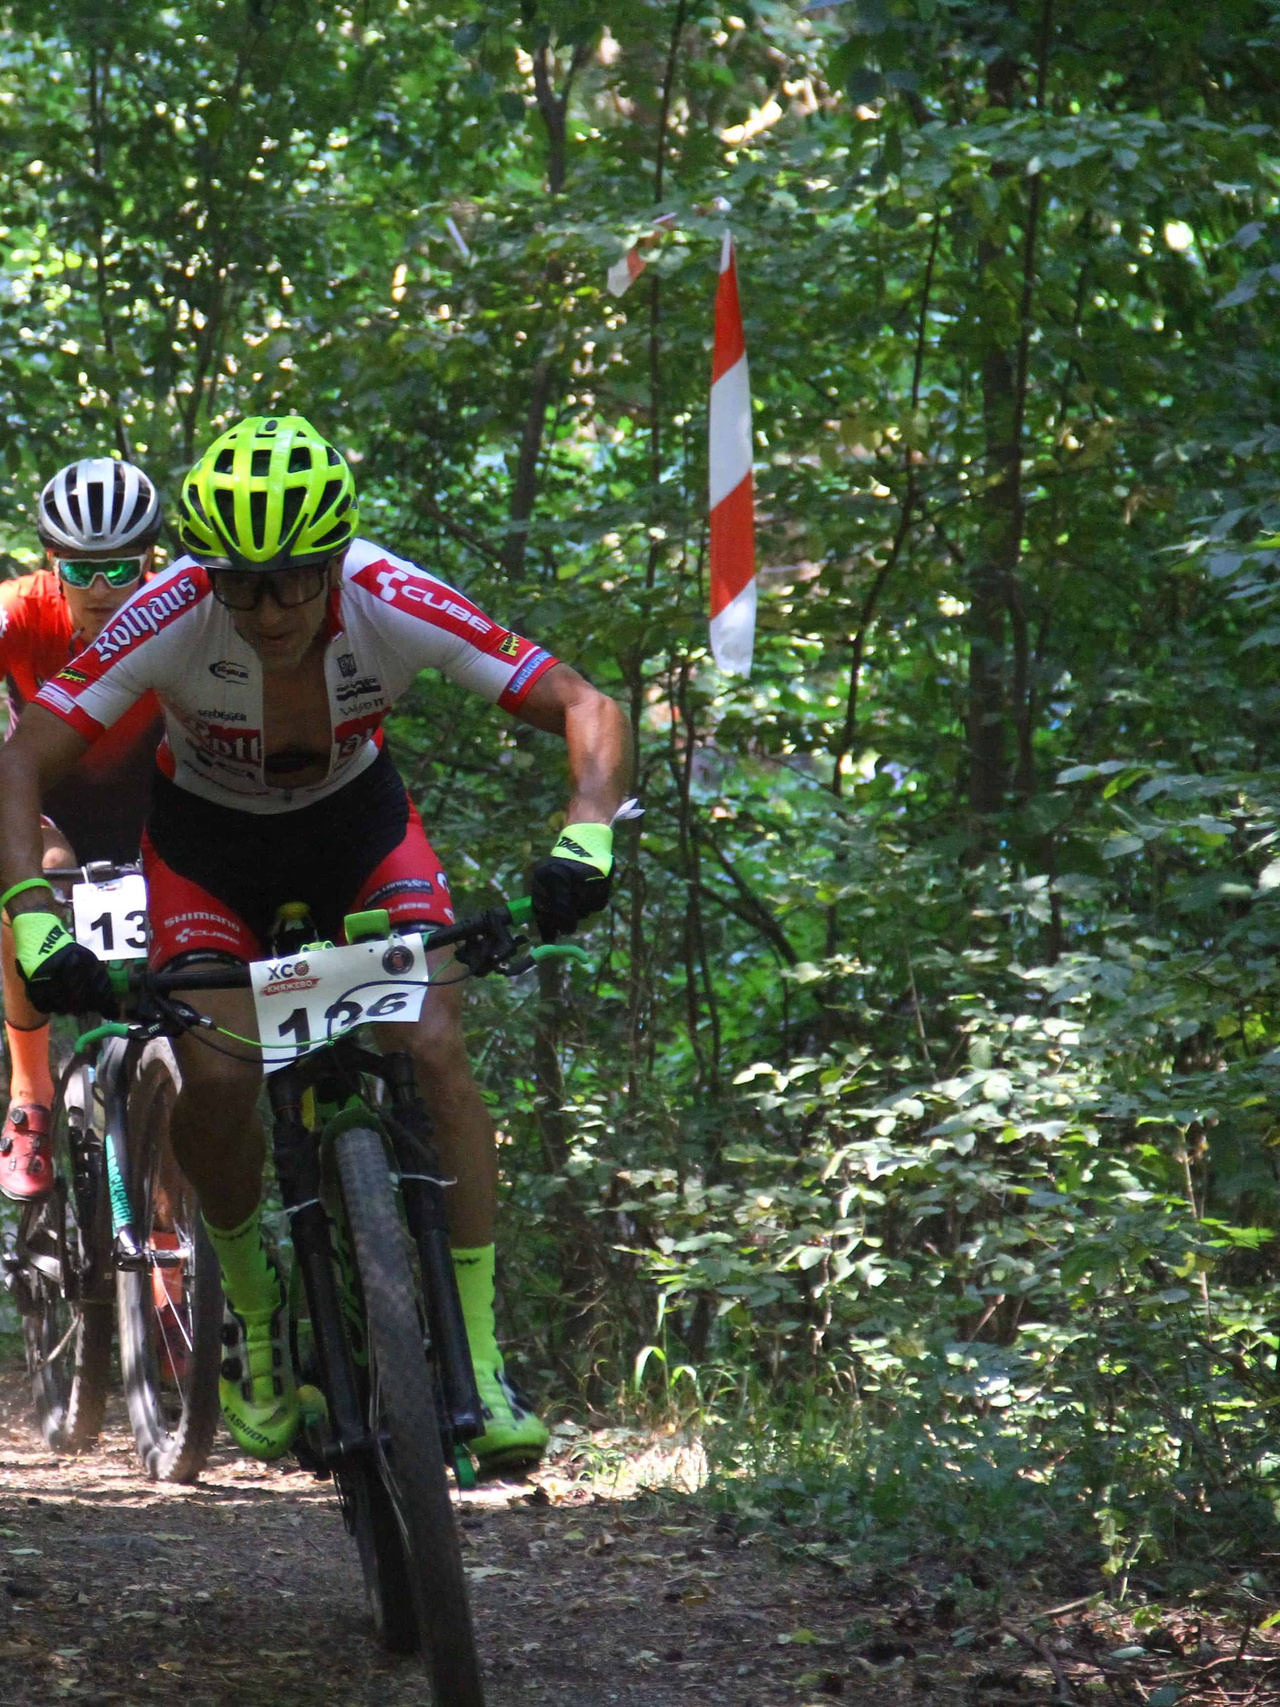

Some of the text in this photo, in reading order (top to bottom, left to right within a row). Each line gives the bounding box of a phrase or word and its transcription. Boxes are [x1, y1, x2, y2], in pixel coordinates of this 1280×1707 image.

[92, 576, 198, 663] Rothaus
[401, 584, 493, 635] CUBE
[37, 924, 66, 955] THOR
[90, 910, 148, 951] 13
[164, 911, 240, 933] SHIMANO
[267, 979, 313, 993] КНЯЖЕВО
